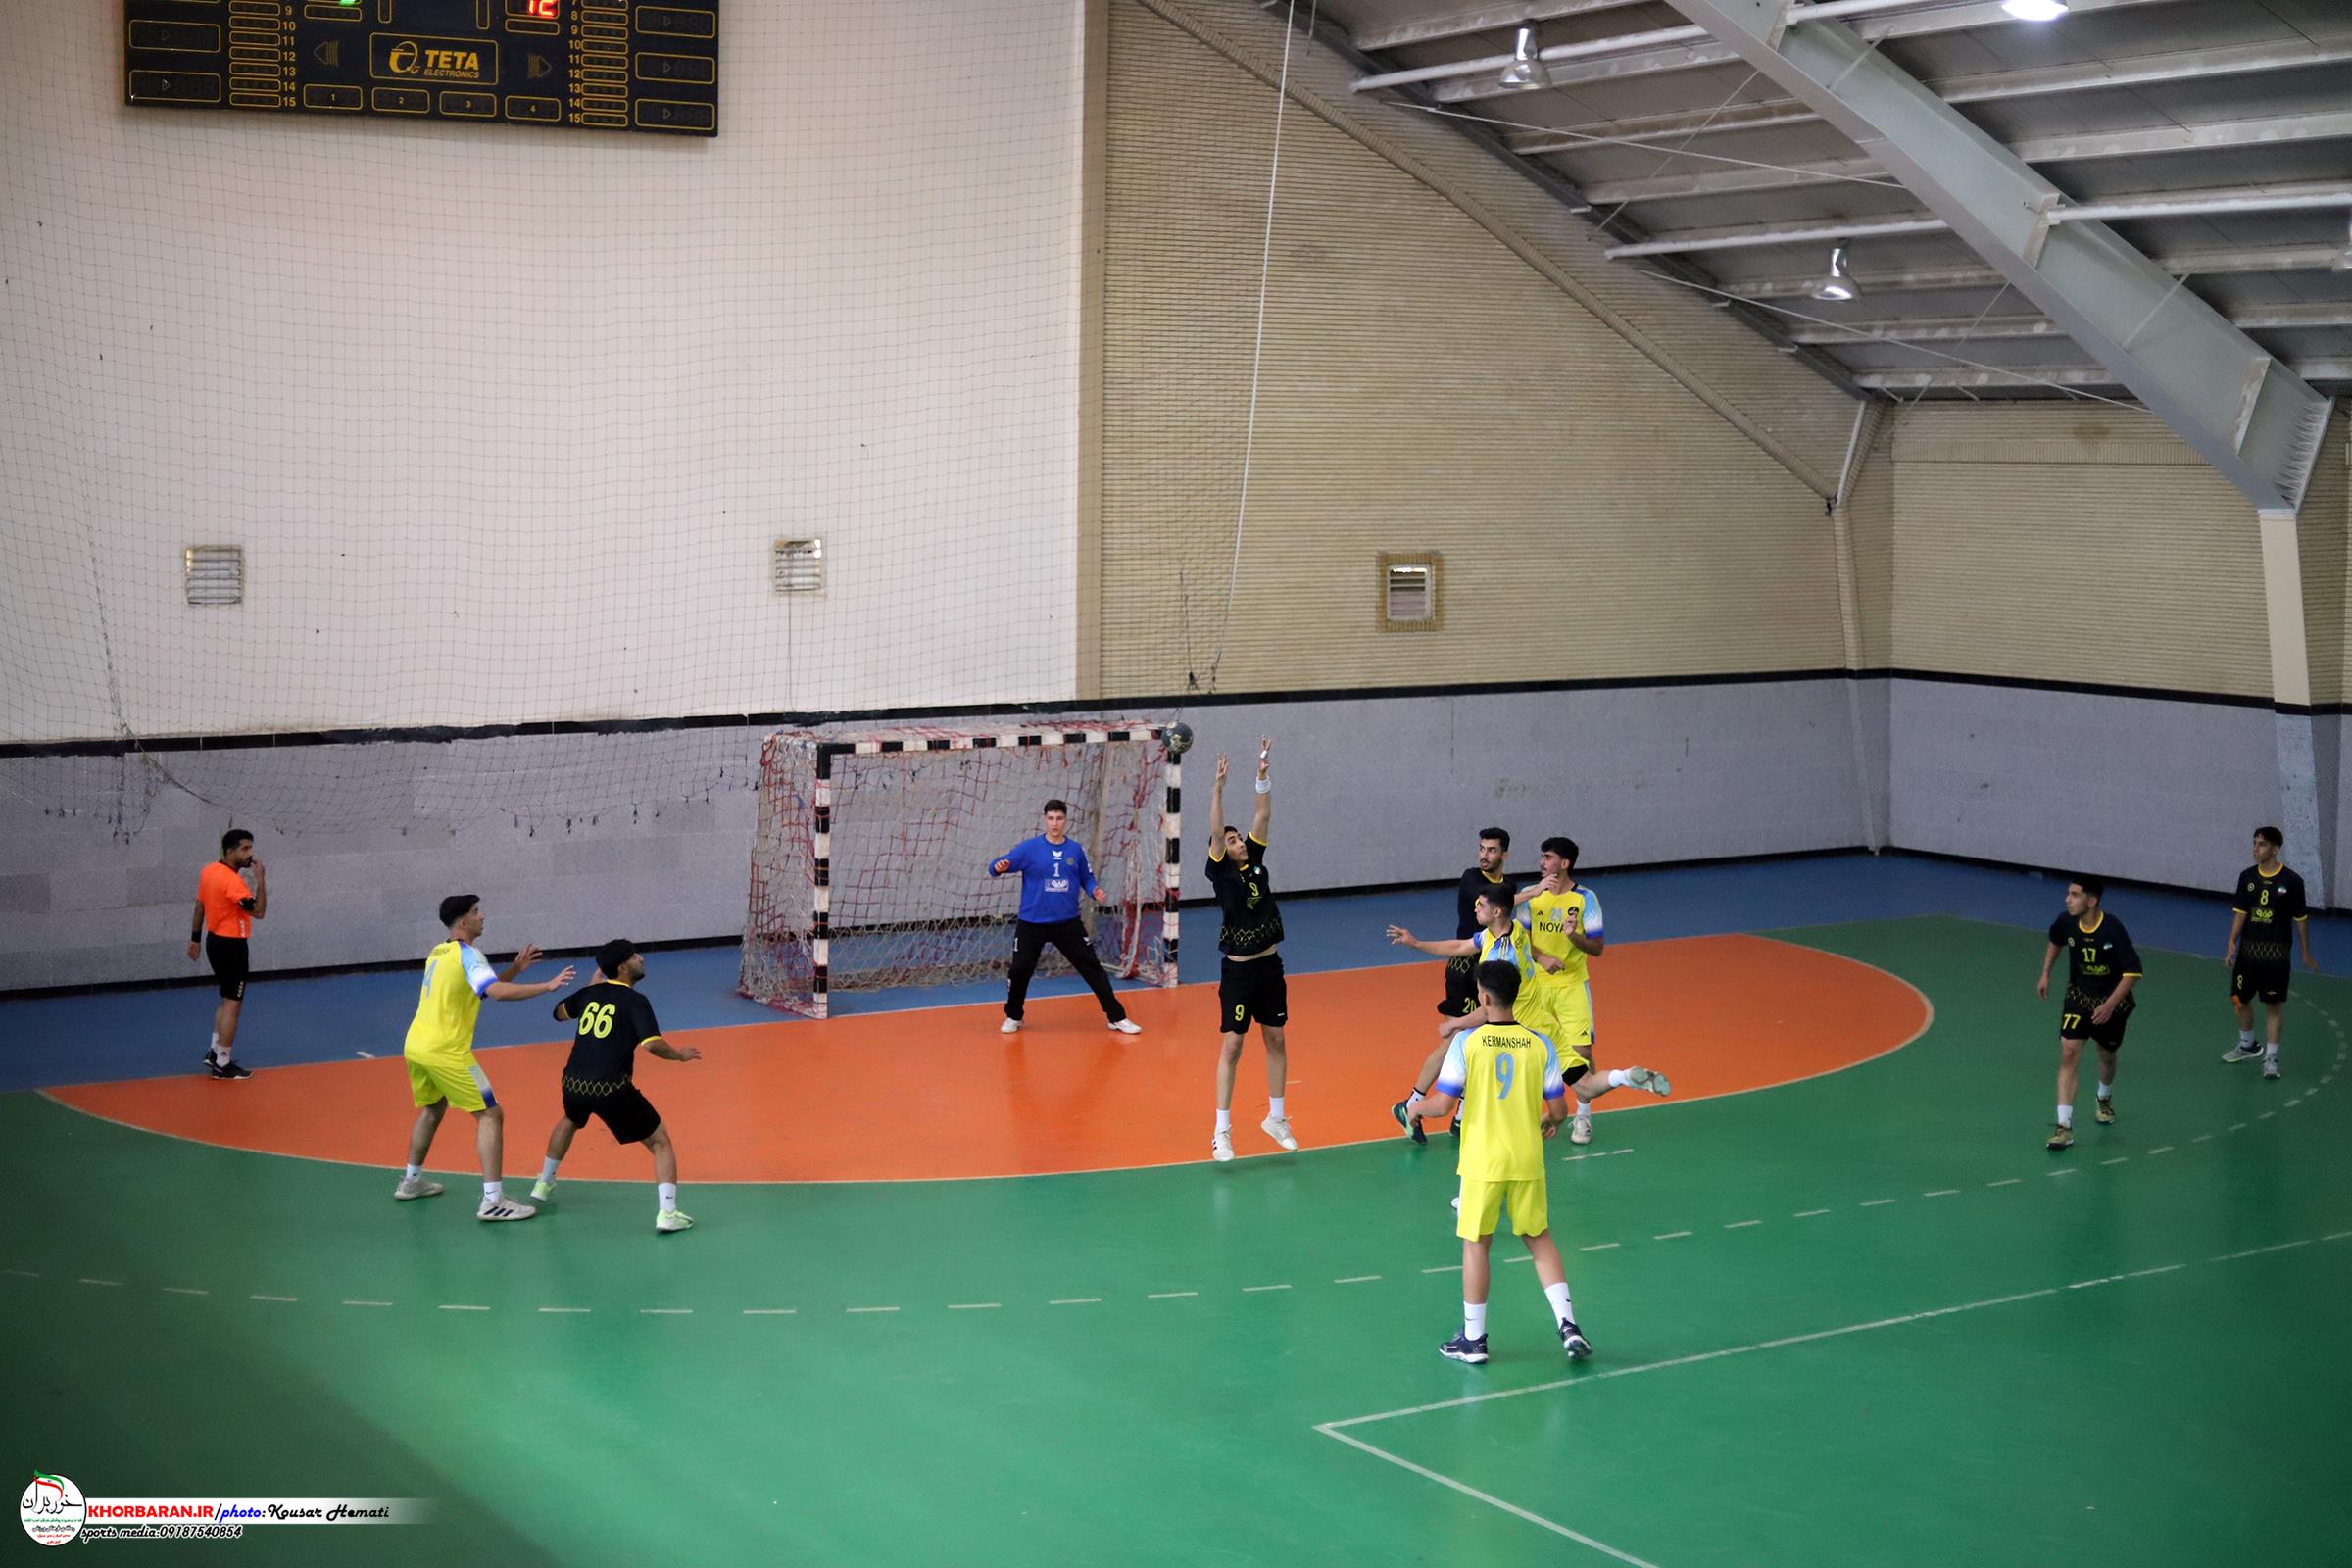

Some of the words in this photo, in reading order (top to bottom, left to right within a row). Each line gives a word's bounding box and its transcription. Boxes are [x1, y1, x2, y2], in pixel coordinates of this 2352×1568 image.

[284, 6, 293, 16] 9
[570, 11, 578, 21] 8
[282, 22, 296, 31] 10
[570, 25, 578, 35] 9
[282, 36, 295, 46] 11
[569, 40, 581, 50] 10
[282, 52, 296, 62] 12
[424, 49, 479, 71] TETA
[569, 54, 580, 64] 11
[282, 67, 296, 76] 13
[423, 68, 480, 79] ELECTRONICS
[569, 69, 581, 79] 12
[282, 81, 296, 91] 14
[569, 84, 581, 94] 13
[283, 97, 296, 107] 15
[569, 98, 581, 108] 14
[569, 113, 581, 122] 15
[1053, 862, 1060, 878] 1
[1249, 882, 1260, 897] 9
[2260, 889, 2270, 906] 8
[1014, 937, 1019, 952] 1
[2082, 947, 2097, 963] 17
[1235, 1004, 1245, 1021] 9
[578, 1001, 615, 1039] 66
[2063, 1013, 2081, 1030] 77
[1482, 1035, 1532, 1049] KERMANSHAH
[1495, 1051, 1514, 1100] 9
